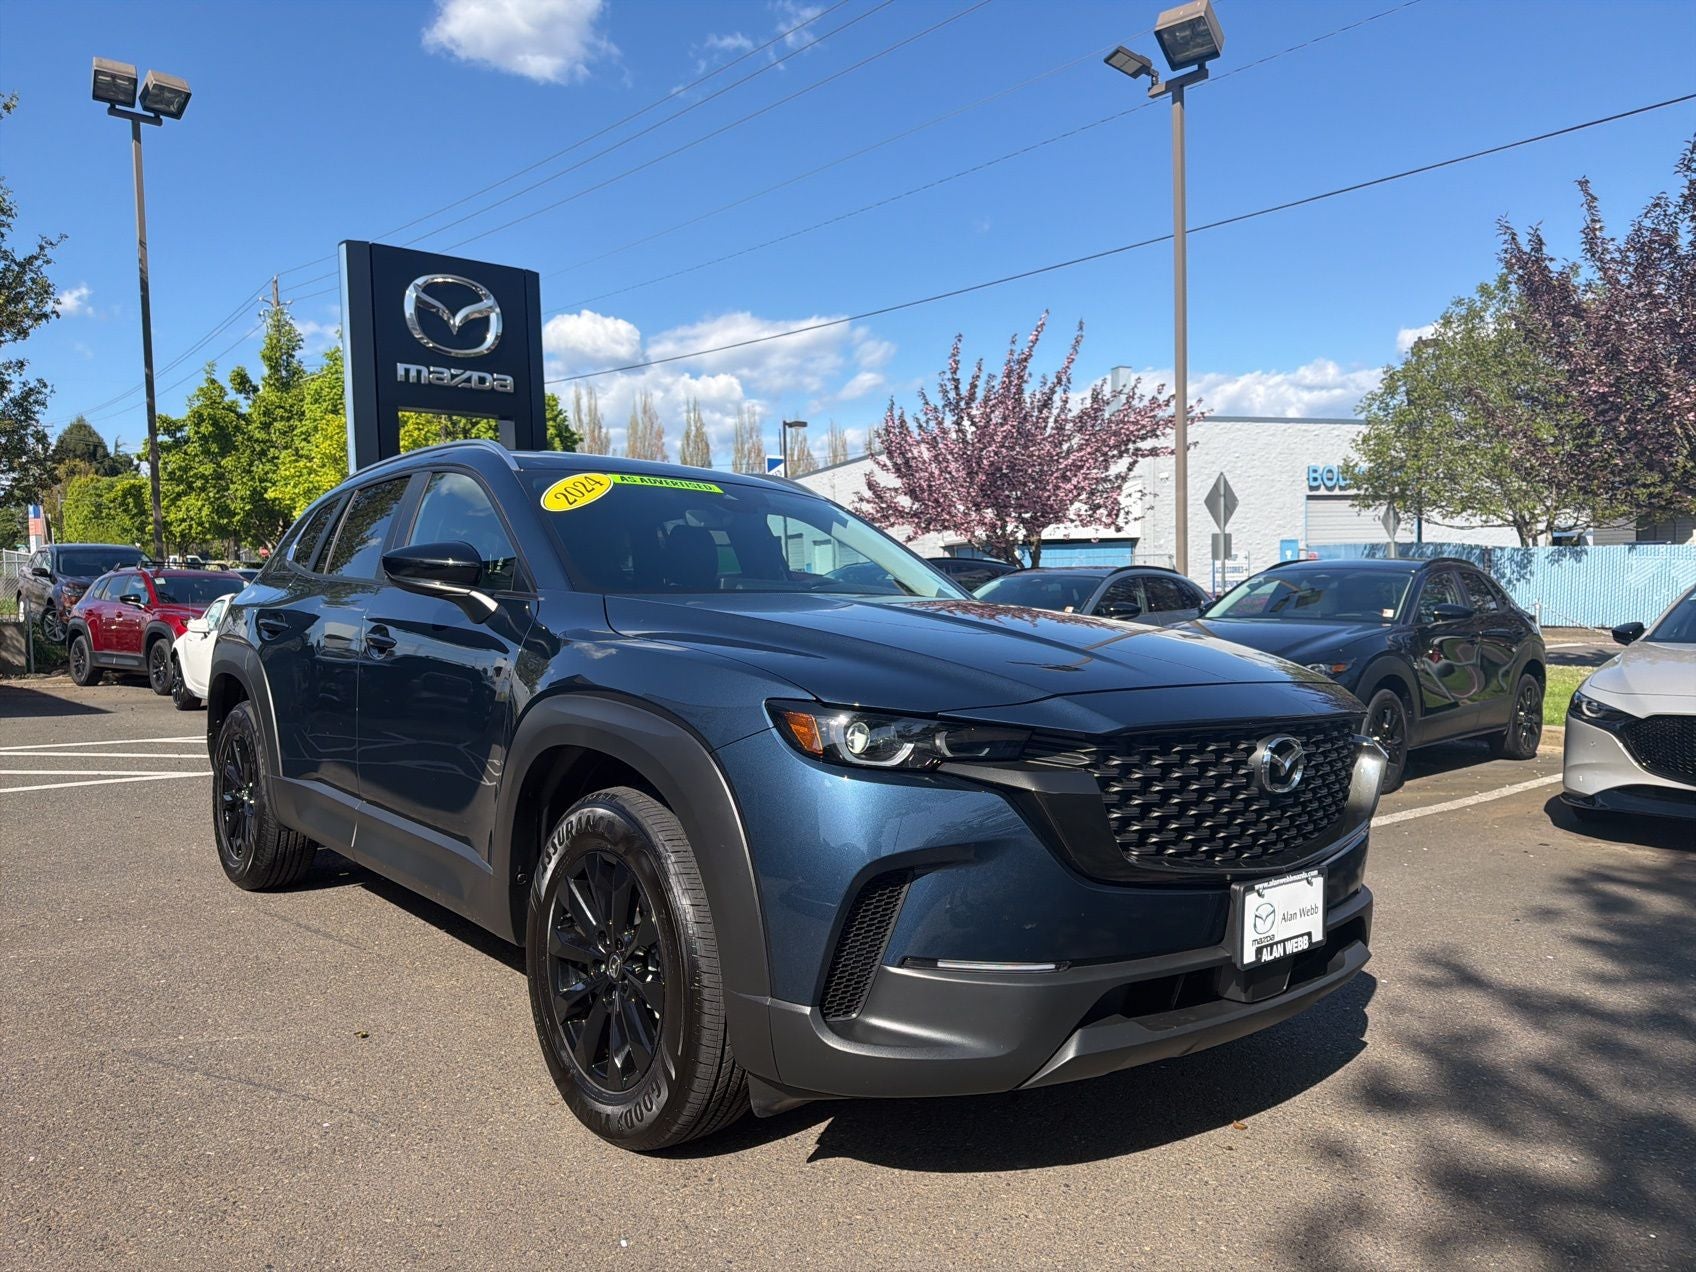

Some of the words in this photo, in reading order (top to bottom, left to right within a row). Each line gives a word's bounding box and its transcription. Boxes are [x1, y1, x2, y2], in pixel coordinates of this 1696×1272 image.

[396, 362, 514, 393] mazda
[554, 476, 604, 506] 2024
[620, 475, 637, 483] AS
[639, 477, 712, 491] ADVERTISED
[1281, 911, 1297, 924] Alan
[1299, 903, 1319, 918] Webb
[1261, 942, 1284, 962] ALAN
[1285, 935, 1309, 955] WEBB
